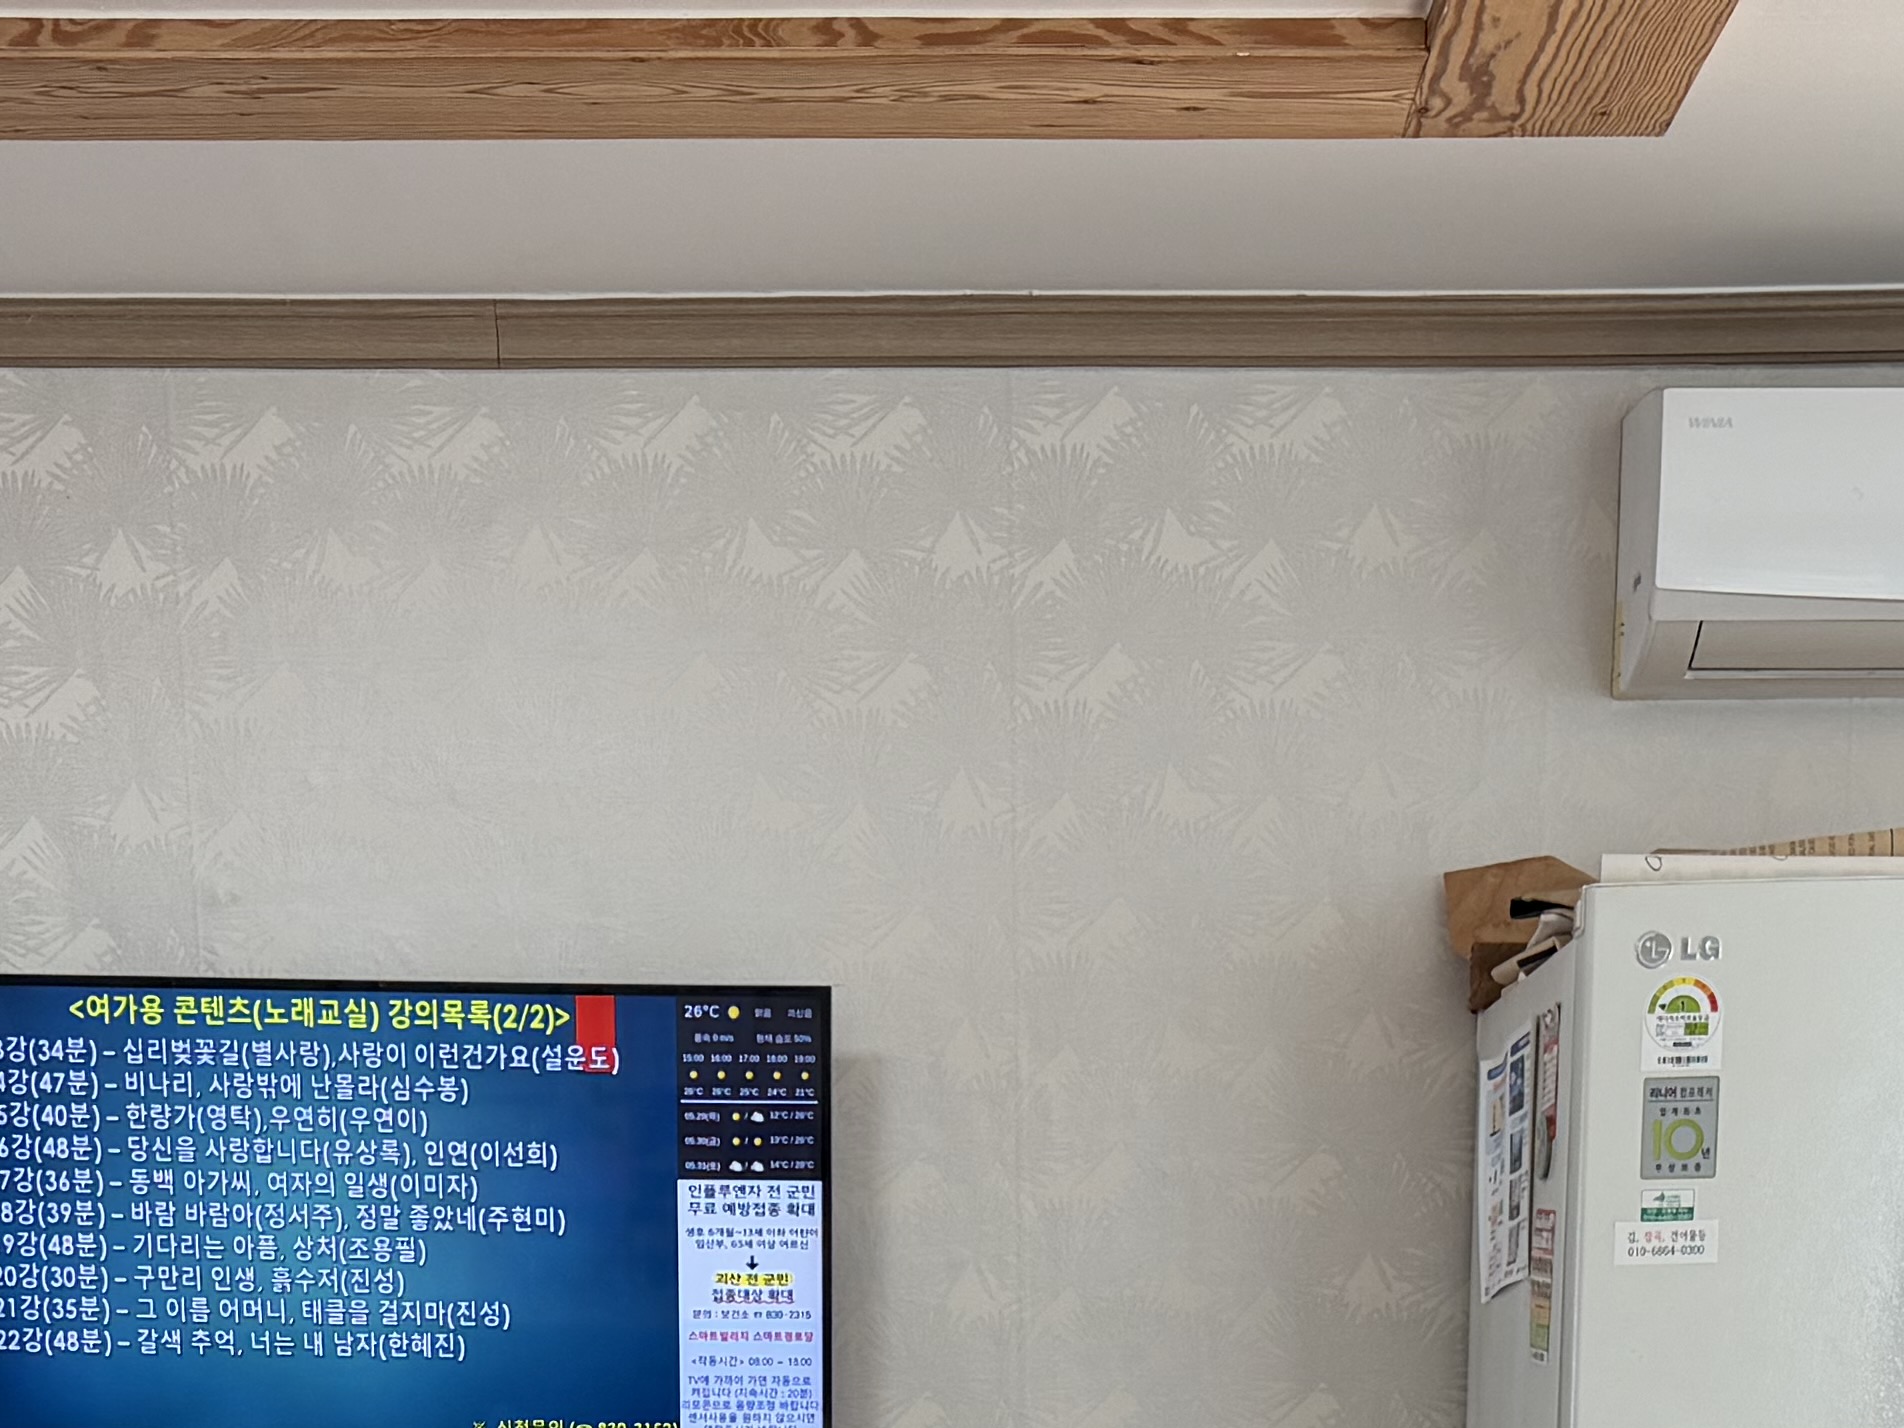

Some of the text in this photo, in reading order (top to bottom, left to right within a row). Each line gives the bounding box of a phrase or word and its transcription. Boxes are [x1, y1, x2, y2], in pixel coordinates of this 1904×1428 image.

[1680, 936, 1722, 960] LG
[69, 994, 571, 1034] <여가용 콘텐츠(노래교실) 강의목록(2/2)>
[684, 1005, 720, 1018] 26°C
[415, 1043, 620, 1074] 이런건가요(설운도)
[125, 1071, 202, 1100] 비나리,
[209, 1072, 302, 1100] 사랑밖에
[311, 1074, 469, 1105] 난몰라(심수봉)
[1649, 1087, 1677, 1099] 리니어
[127, 1136, 197, 1163] 당신을
[205, 1136, 417, 1169] 사랑합니다(유상록),
[425, 1140, 558, 1171] 인연(이선희)
[129, 1168, 175, 1195] 동백
[184, 1169, 260, 1197] 아가씨,
[267, 1171, 336, 1199] 여자의
[344, 1172, 479, 1201] 일생(이미자)
[767, 1185, 781, 1199] 전
[131, 1201, 176, 1227] 바람
[185, 1202, 349, 1233] 바람아(정서주),
[356, 1204, 400, 1231] 정말
[409, 1205, 566, 1236] 좋았네(주현미)
[688, 1202, 815, 1217] 무료 예방접종 확대
[133, 1234, 224, 1259] 기다리는
[233, 1235, 286, 1261] 아픔,
[292, 1235, 428, 1266] 상처(조용필)
[133, 1265, 202, 1291] 구만리
[211, 1267, 263, 1293] 인생,
[271, 1267, 405, 1297] 흙수저(진성)
[135, 1299, 158, 1319] 그
[166, 1298, 211, 1323] 이름
[219, 1298, 295, 1325] 어머니,
[302, 1299, 369, 1326] 태클을
[378, 1301, 511, 1330] 걸지마(진성)
[137, 1329, 182, 1355] 갈색
[191, 1330, 243, 1357] 추억,
[250, 1332, 295, 1356] 너는
[303, 1332, 324, 1357] 내
[333, 1332, 466, 1361] 남자(한혜진)
